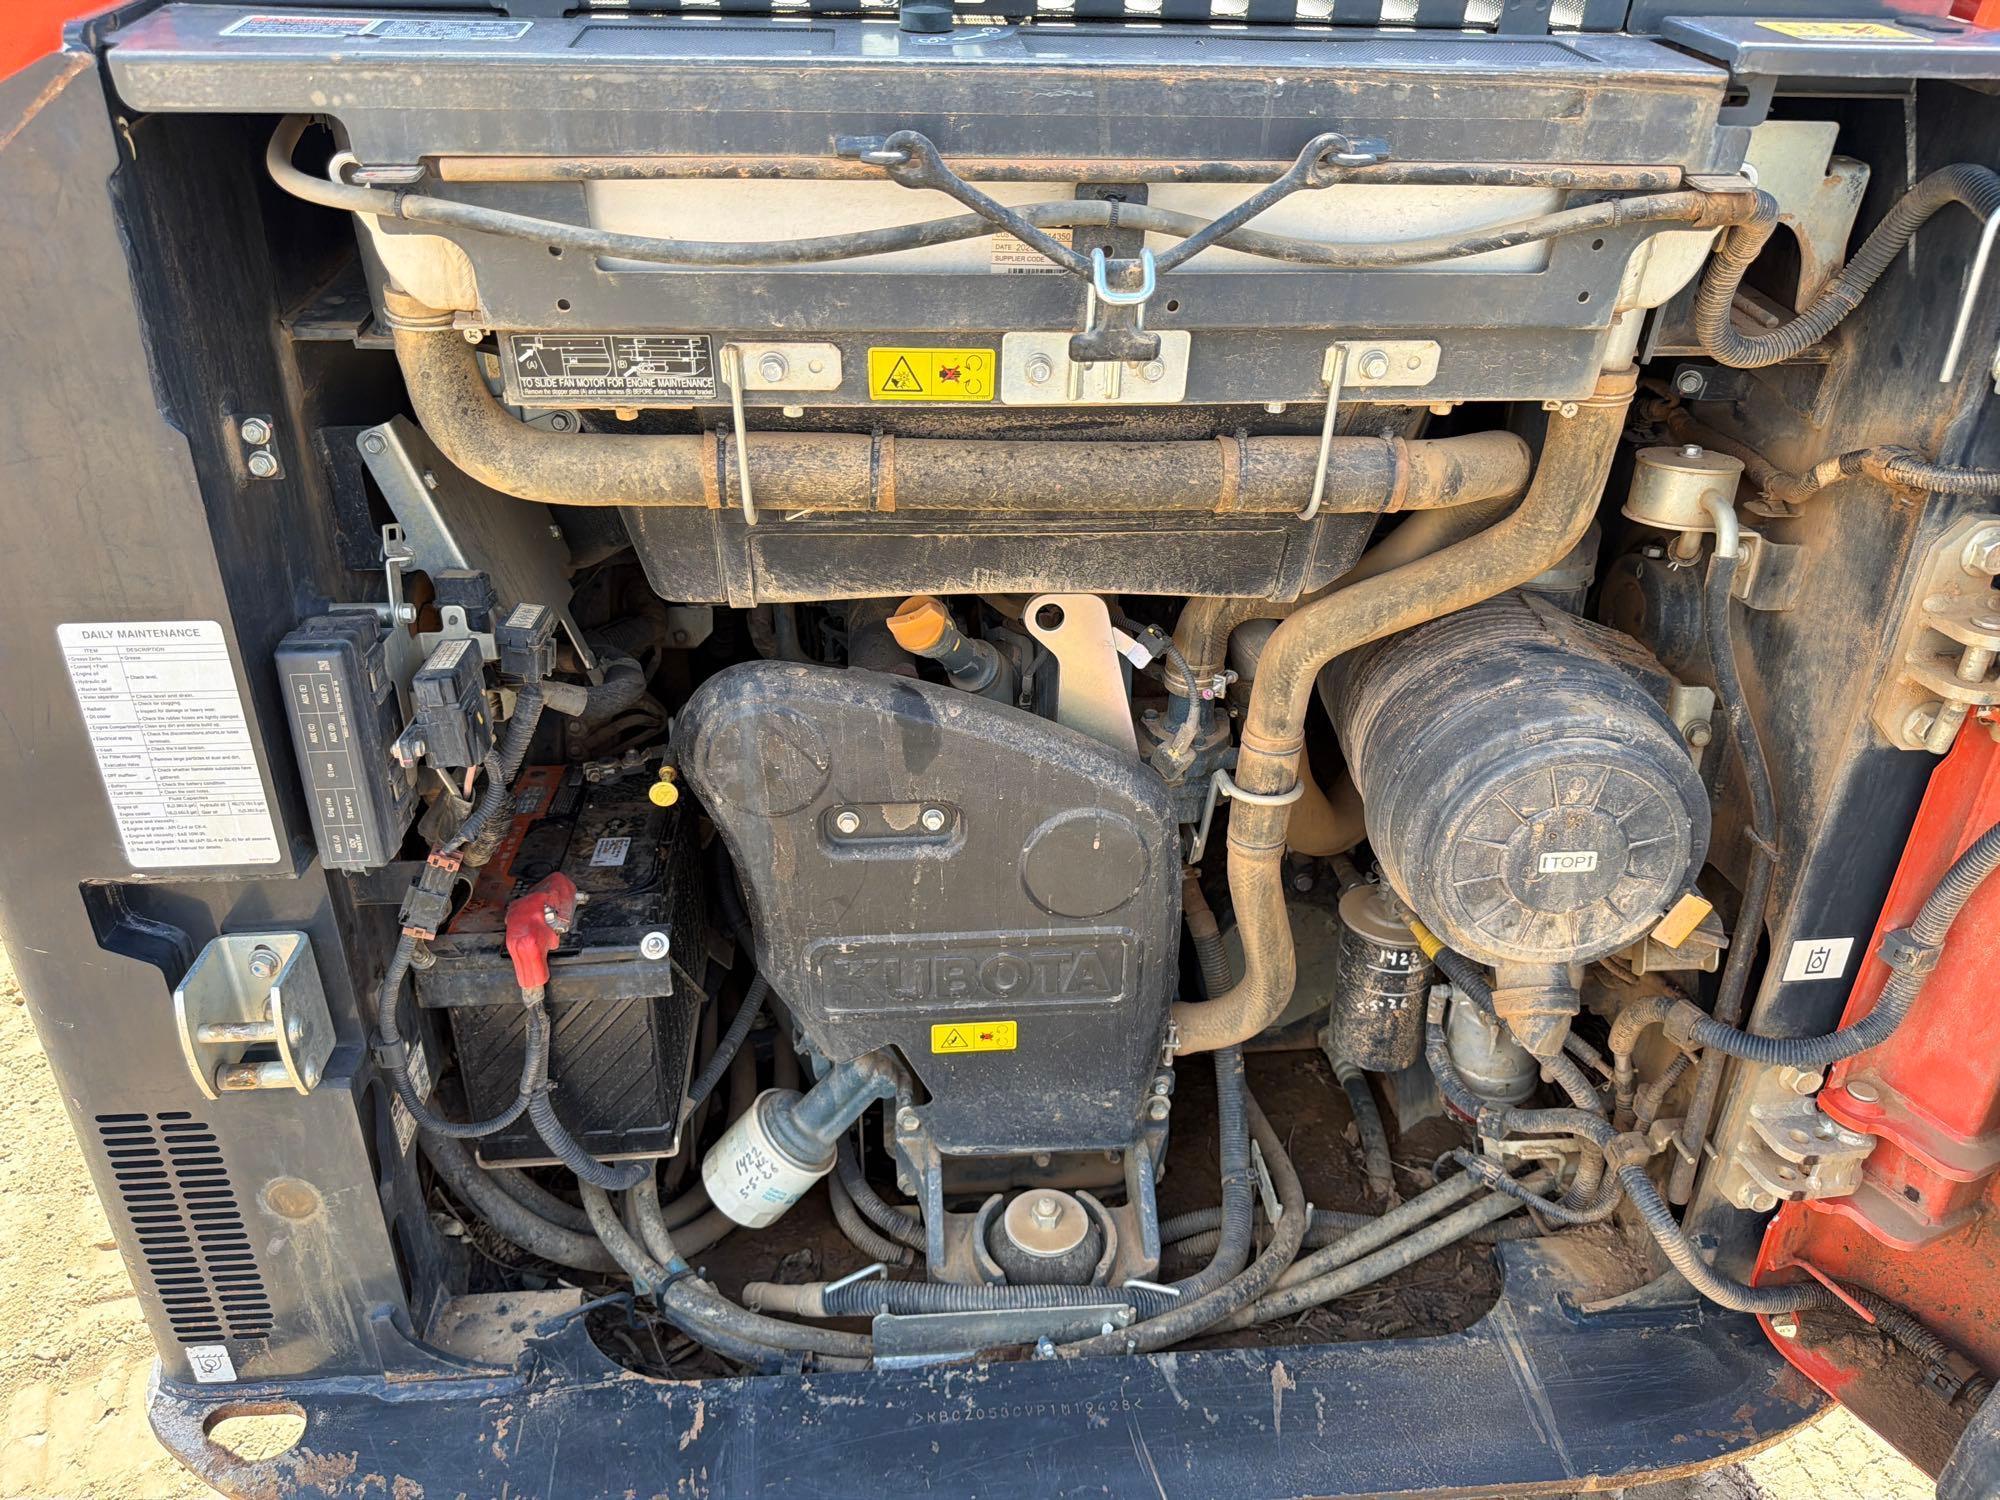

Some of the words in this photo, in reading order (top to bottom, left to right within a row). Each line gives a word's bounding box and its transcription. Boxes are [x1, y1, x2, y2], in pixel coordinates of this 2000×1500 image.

[526, 360, 538, 370] (A)
[617, 360, 628, 369] (B)
[522, 378, 533, 388] TO
[534, 378, 558, 388] SLIDE
[559, 378, 574, 388] FAN
[576, 378, 606, 388] MOTOR
[607, 378, 624, 388] FOR
[626, 378, 656, 388] ENGINE
[658, 378, 713, 388] MAINTENANCE
[82, 630, 113, 639] DAILY
[117, 628, 200, 638] MAINTENANCE
[319, 684, 328, 692] (F)
[300, 693, 310, 704] AUX
[320, 693, 330, 704] AUX
[309, 732, 319, 743] AUX
[329, 732, 339, 743] AUX
[327, 763, 335, 778] Glow
[325, 798, 335, 818] Engine
[344, 795, 354, 819] Starter
[335, 843, 344, 854] AUX
[354, 834, 364, 853] heater
[1551, 856, 1586, 868] TOP
[1380, 950, 1420, 966] 1422
[831, 952, 1112, 1001] KUBOTA
[736, 1146, 762, 1176] 1422
